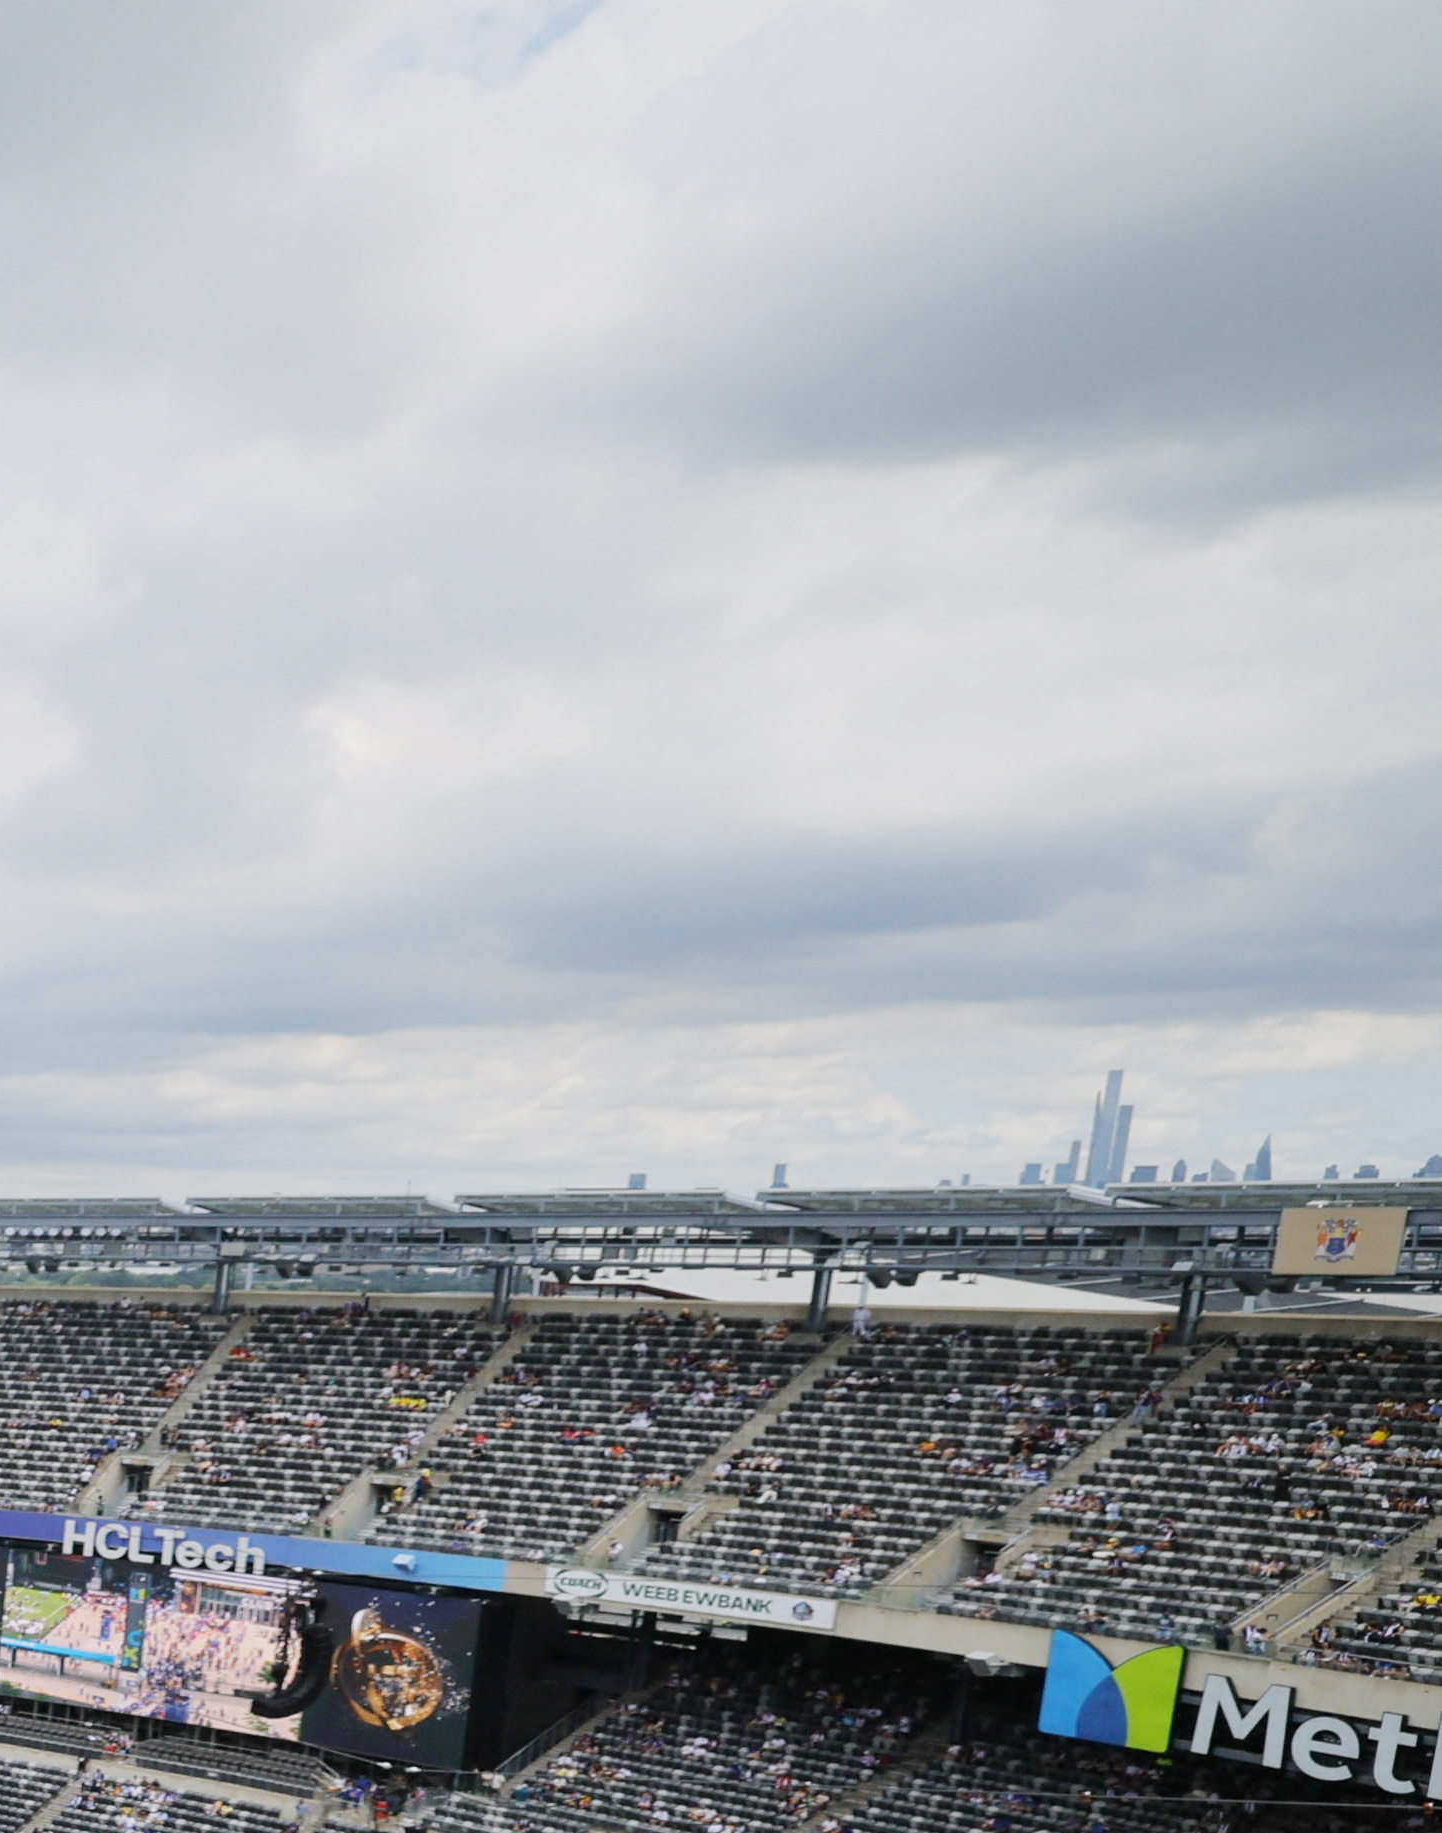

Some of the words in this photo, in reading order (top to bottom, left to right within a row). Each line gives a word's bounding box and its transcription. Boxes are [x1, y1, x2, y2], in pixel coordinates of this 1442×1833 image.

[62, 1519, 266, 1576] HCLTech
[622, 1582, 677, 1601] WEEB
[682, 1591, 772, 1614] EWBANK
[1190, 1673, 1442, 1800] Met
